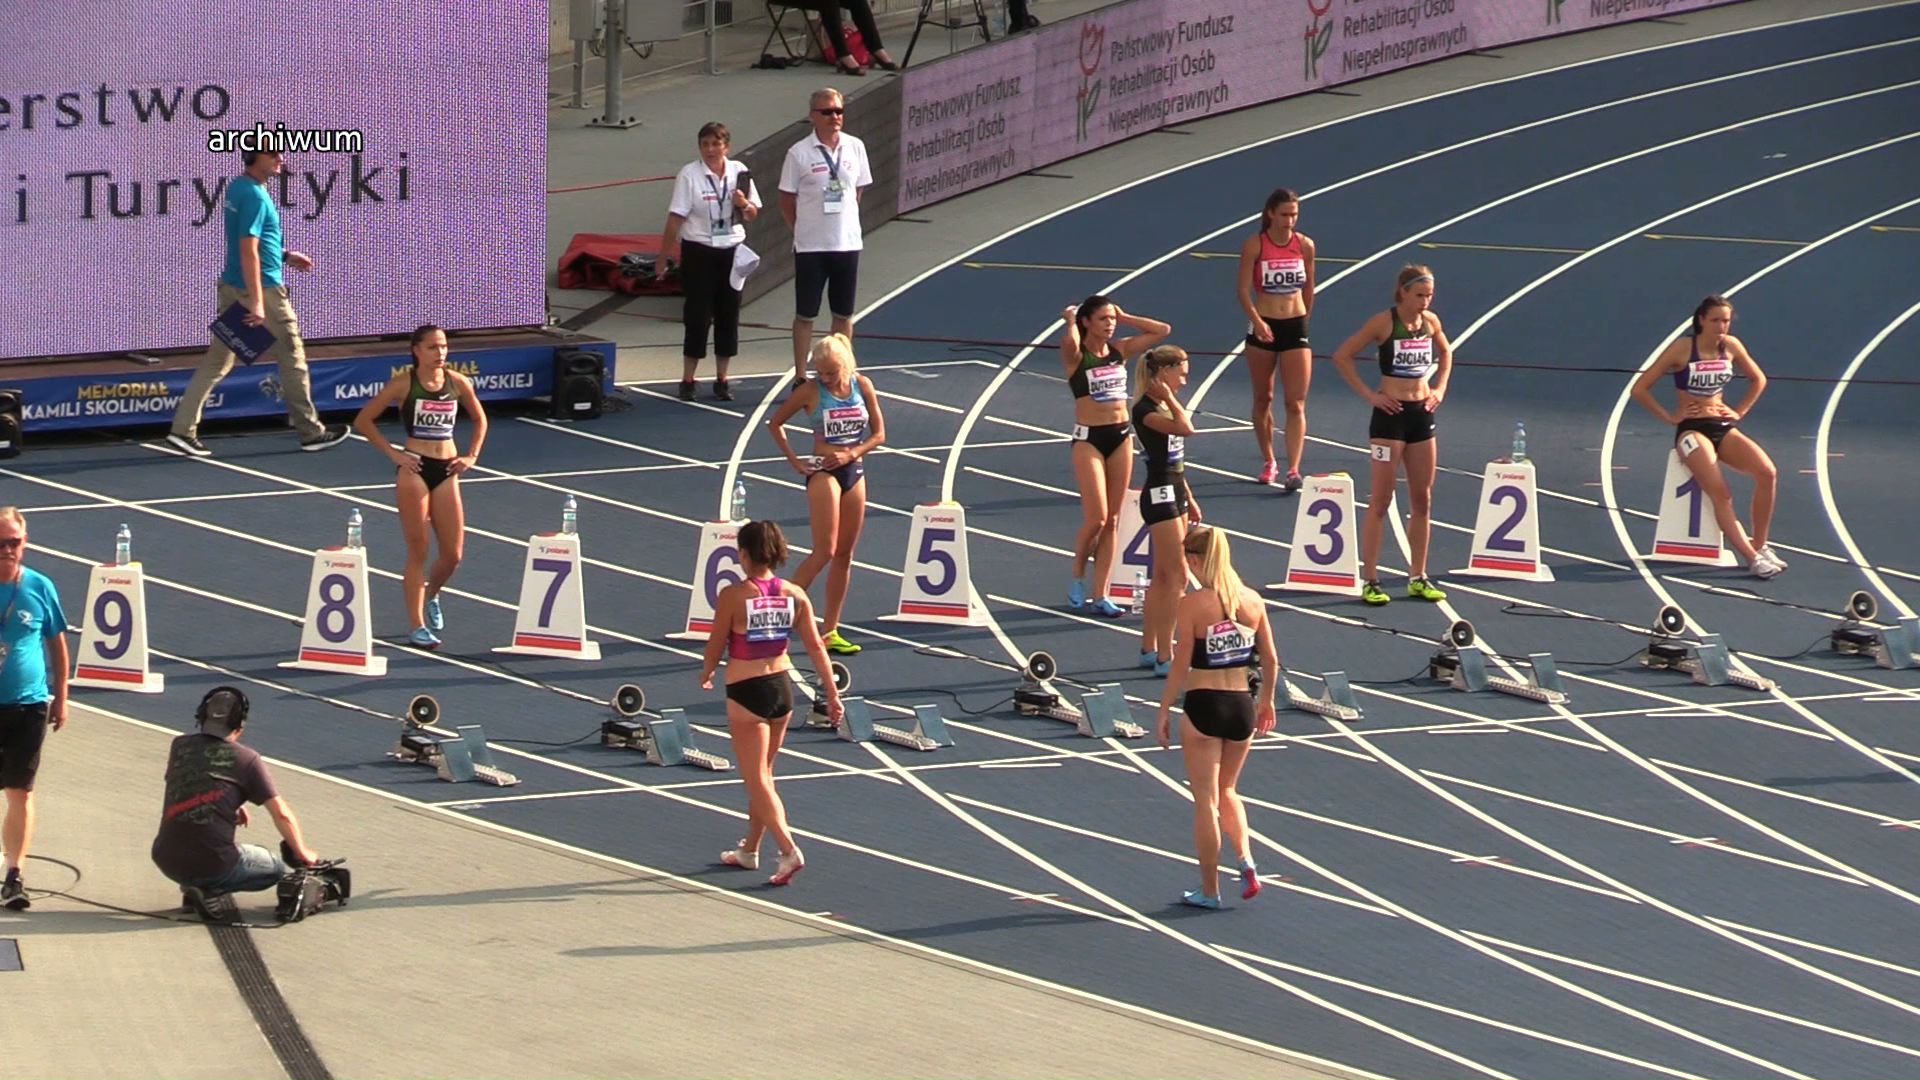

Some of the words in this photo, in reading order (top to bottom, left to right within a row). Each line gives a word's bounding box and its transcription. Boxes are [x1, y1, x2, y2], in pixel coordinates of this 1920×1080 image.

[1110, 27, 1175, 64] Państwowy
[1178, 14, 1235, 44] Fundusz
[1342, 21, 1467, 74] Niepełnosprawnych
[1109, 55, 1177, 98] Rehabilitacji
[1181, 48, 1216, 78] Osób
[907, 91, 974, 130] Państwowy
[976, 76, 1021, 107] Fundusz
[1108, 78, 1229, 132] Niepełnosprawnych
[906, 120, 975, 165] Rehabilitacji
[977, 111, 1005, 142] Osób
[15, 173, 27, 223] i
[65, 152, 409, 227] Turytyki
[904, 143, 1015, 201] Niepełnosprawnych
[21, 401, 80, 420] KAMILI
[84, 393, 224, 416] SKOLIMOWEJ
[77, 381, 169, 400] MEMORIAŁ
[1075, 426, 1082, 438] 4
[1376, 446, 1384, 459] 3
[1684, 438, 1693, 450] 1
[1159, 487, 1168, 500] 5
[1485, 485, 1528, 553] 2
[1676, 475, 1703, 538] 1
[1122, 522, 1156, 580] 4
[1304, 498, 1344, 566] 3
[704, 545, 743, 611] 6
[915, 527, 957, 596] 5
[316, 573, 355, 643] 8
[532, 558, 572, 628] 7
[93, 590, 133, 661] 9
